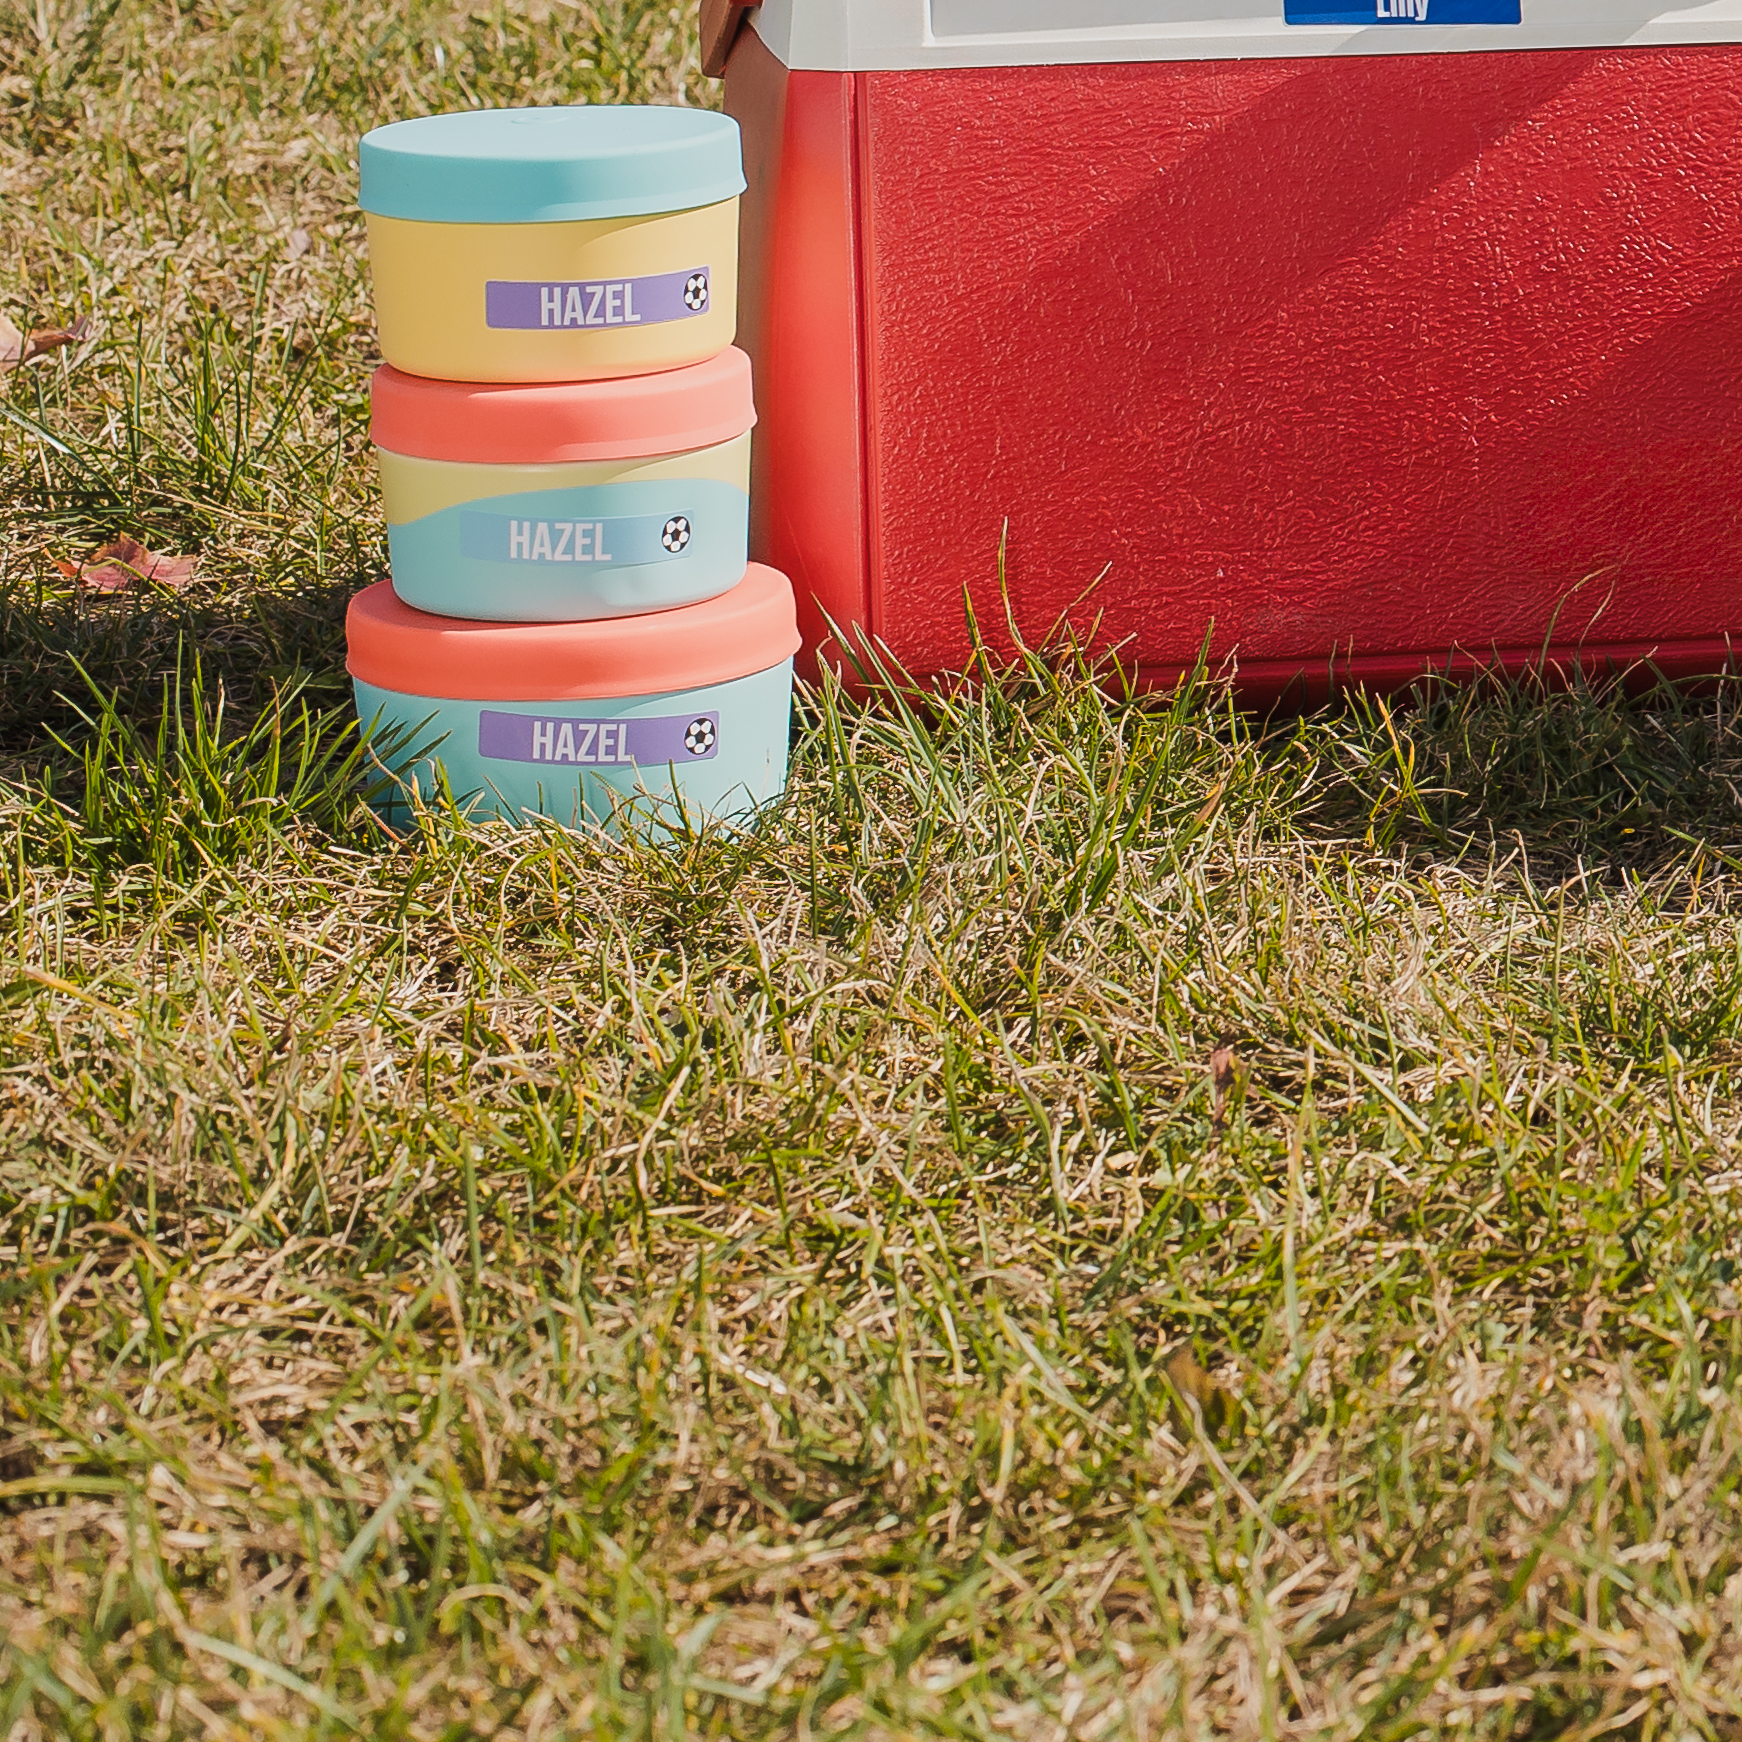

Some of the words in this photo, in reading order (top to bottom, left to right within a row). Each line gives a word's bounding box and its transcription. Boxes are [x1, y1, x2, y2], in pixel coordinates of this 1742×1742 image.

[540, 283, 642, 326] HAZEL
[509, 519, 612, 562] HAZEL
[532, 720, 635, 763] HAZEL
